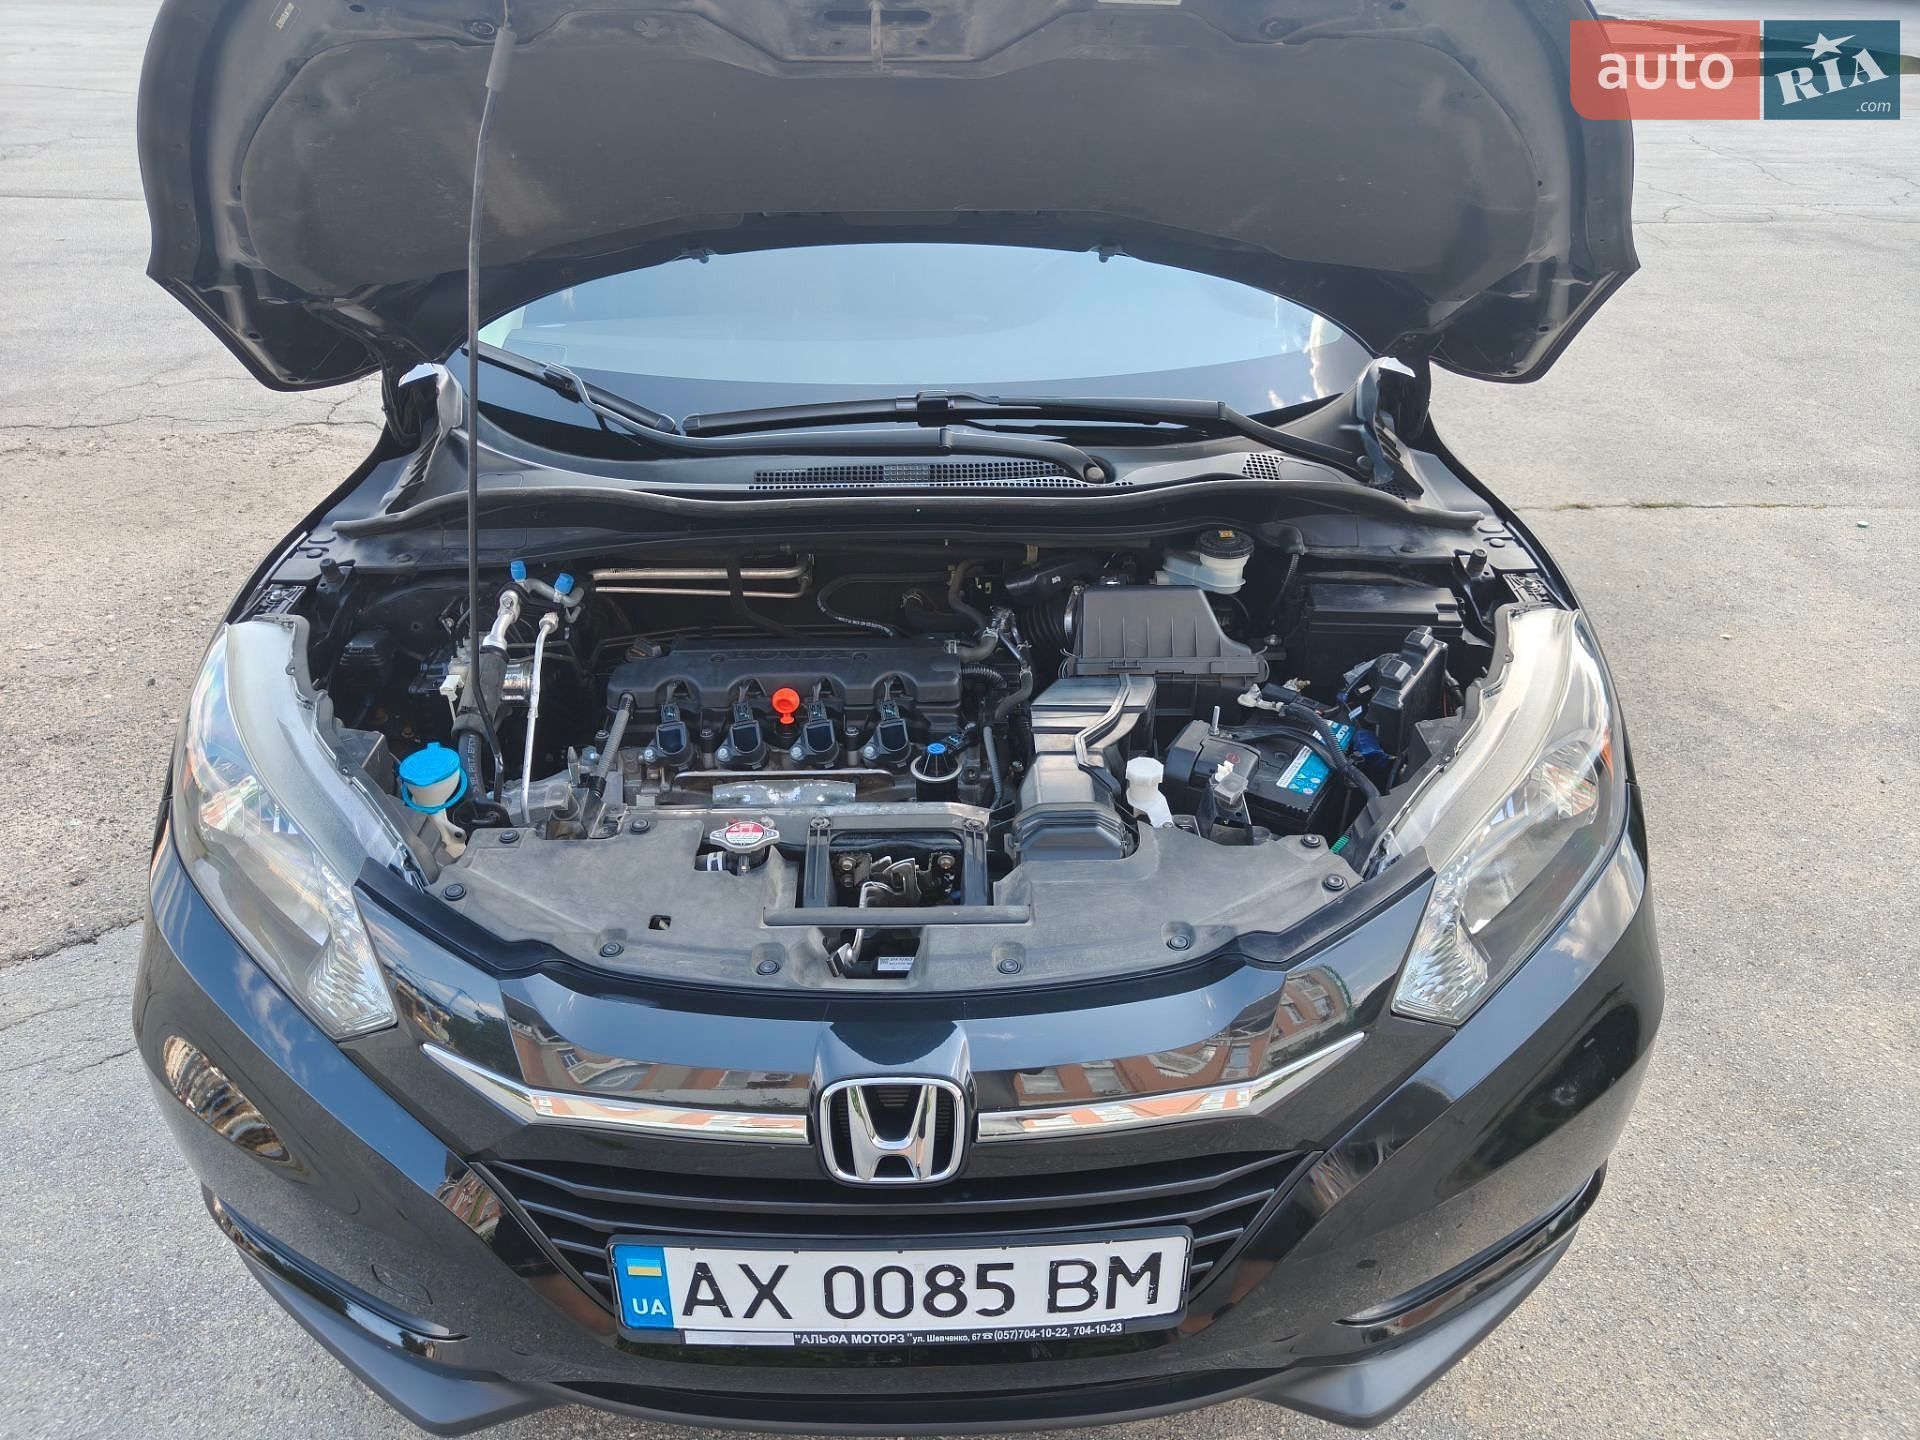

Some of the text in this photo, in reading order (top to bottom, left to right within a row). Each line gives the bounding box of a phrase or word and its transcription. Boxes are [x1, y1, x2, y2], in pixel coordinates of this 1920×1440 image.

[682, 1251, 1162, 1320] AX 0085 BM
[632, 1297, 668, 1315] UA
[794, 1334, 848, 1344] "АЛЬФА
[971, 1332, 981, 1341] 67
[1073, 1322, 1122, 1336] 704-10-23
